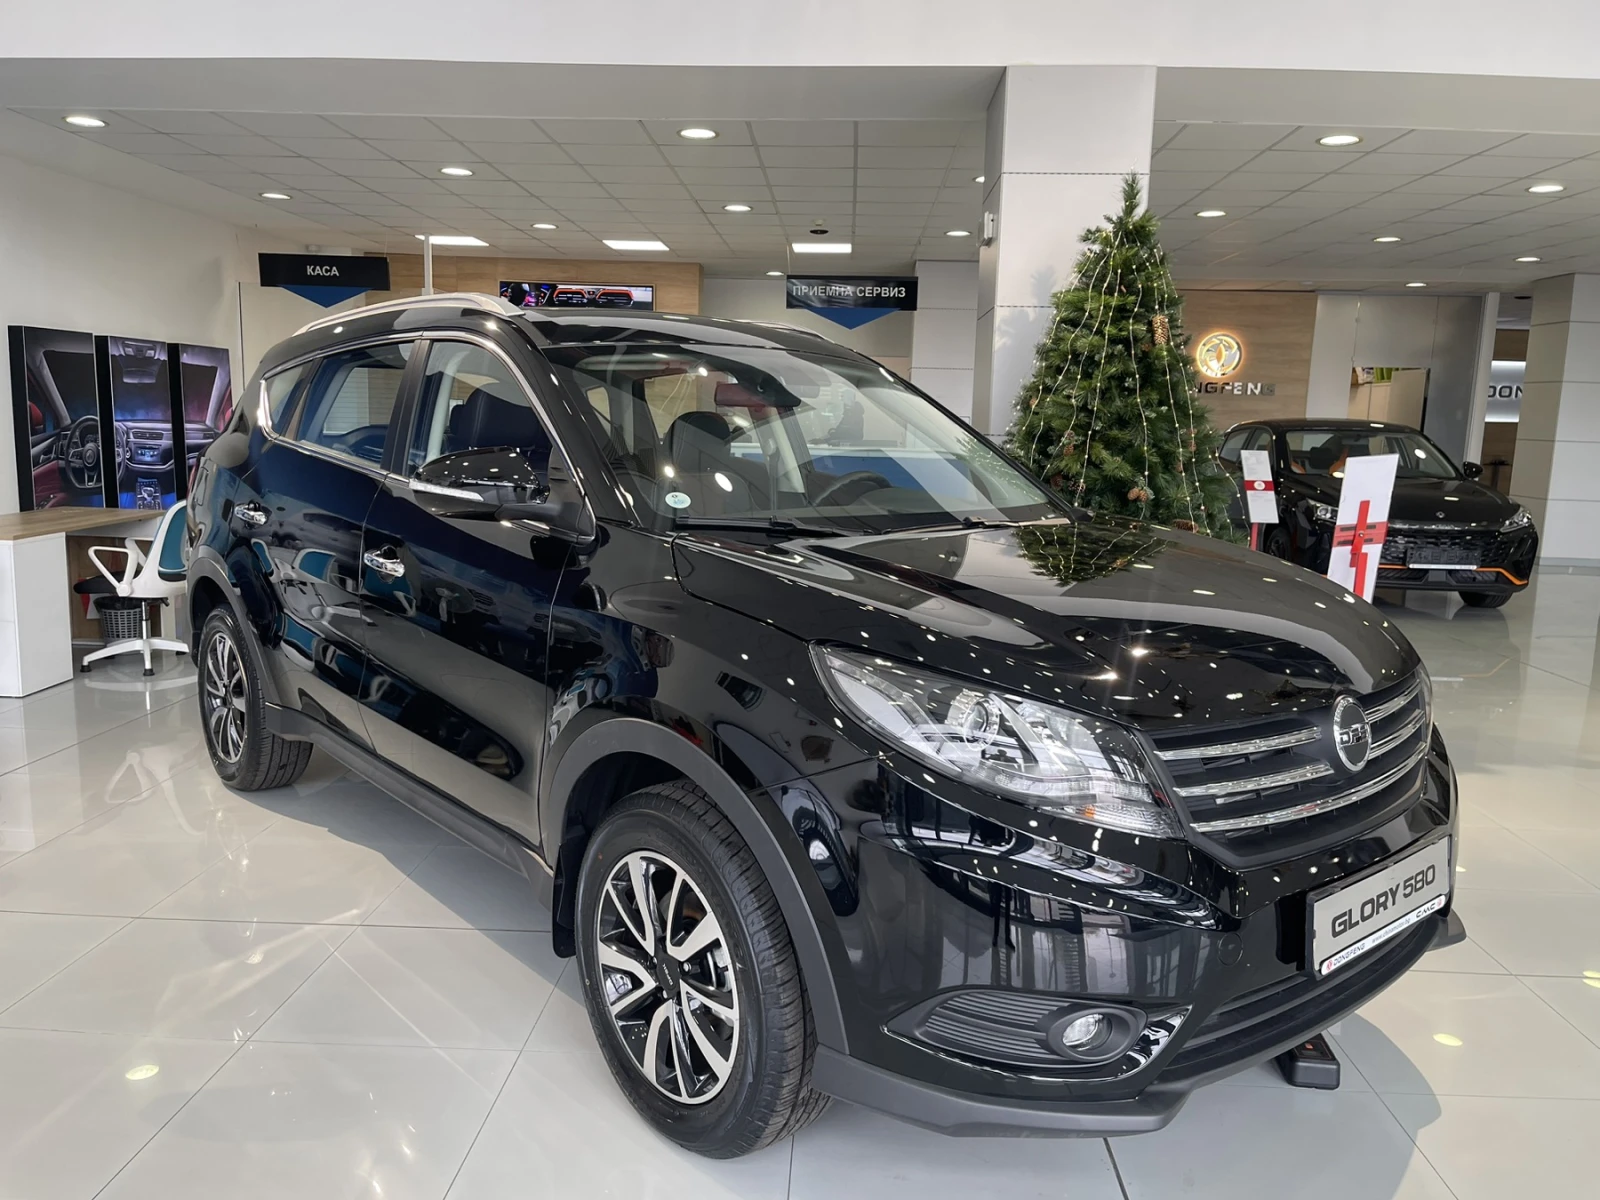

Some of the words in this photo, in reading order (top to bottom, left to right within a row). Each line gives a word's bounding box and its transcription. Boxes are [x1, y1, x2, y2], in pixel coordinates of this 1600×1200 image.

[306, 265, 340, 277] КАСА
[792, 285, 854, 297] ПРИЕМНА
[856, 286, 906, 297] СЕРВИЗ
[1331, 882, 1401, 938] GLORY
[1402, 864, 1436, 899] 580
